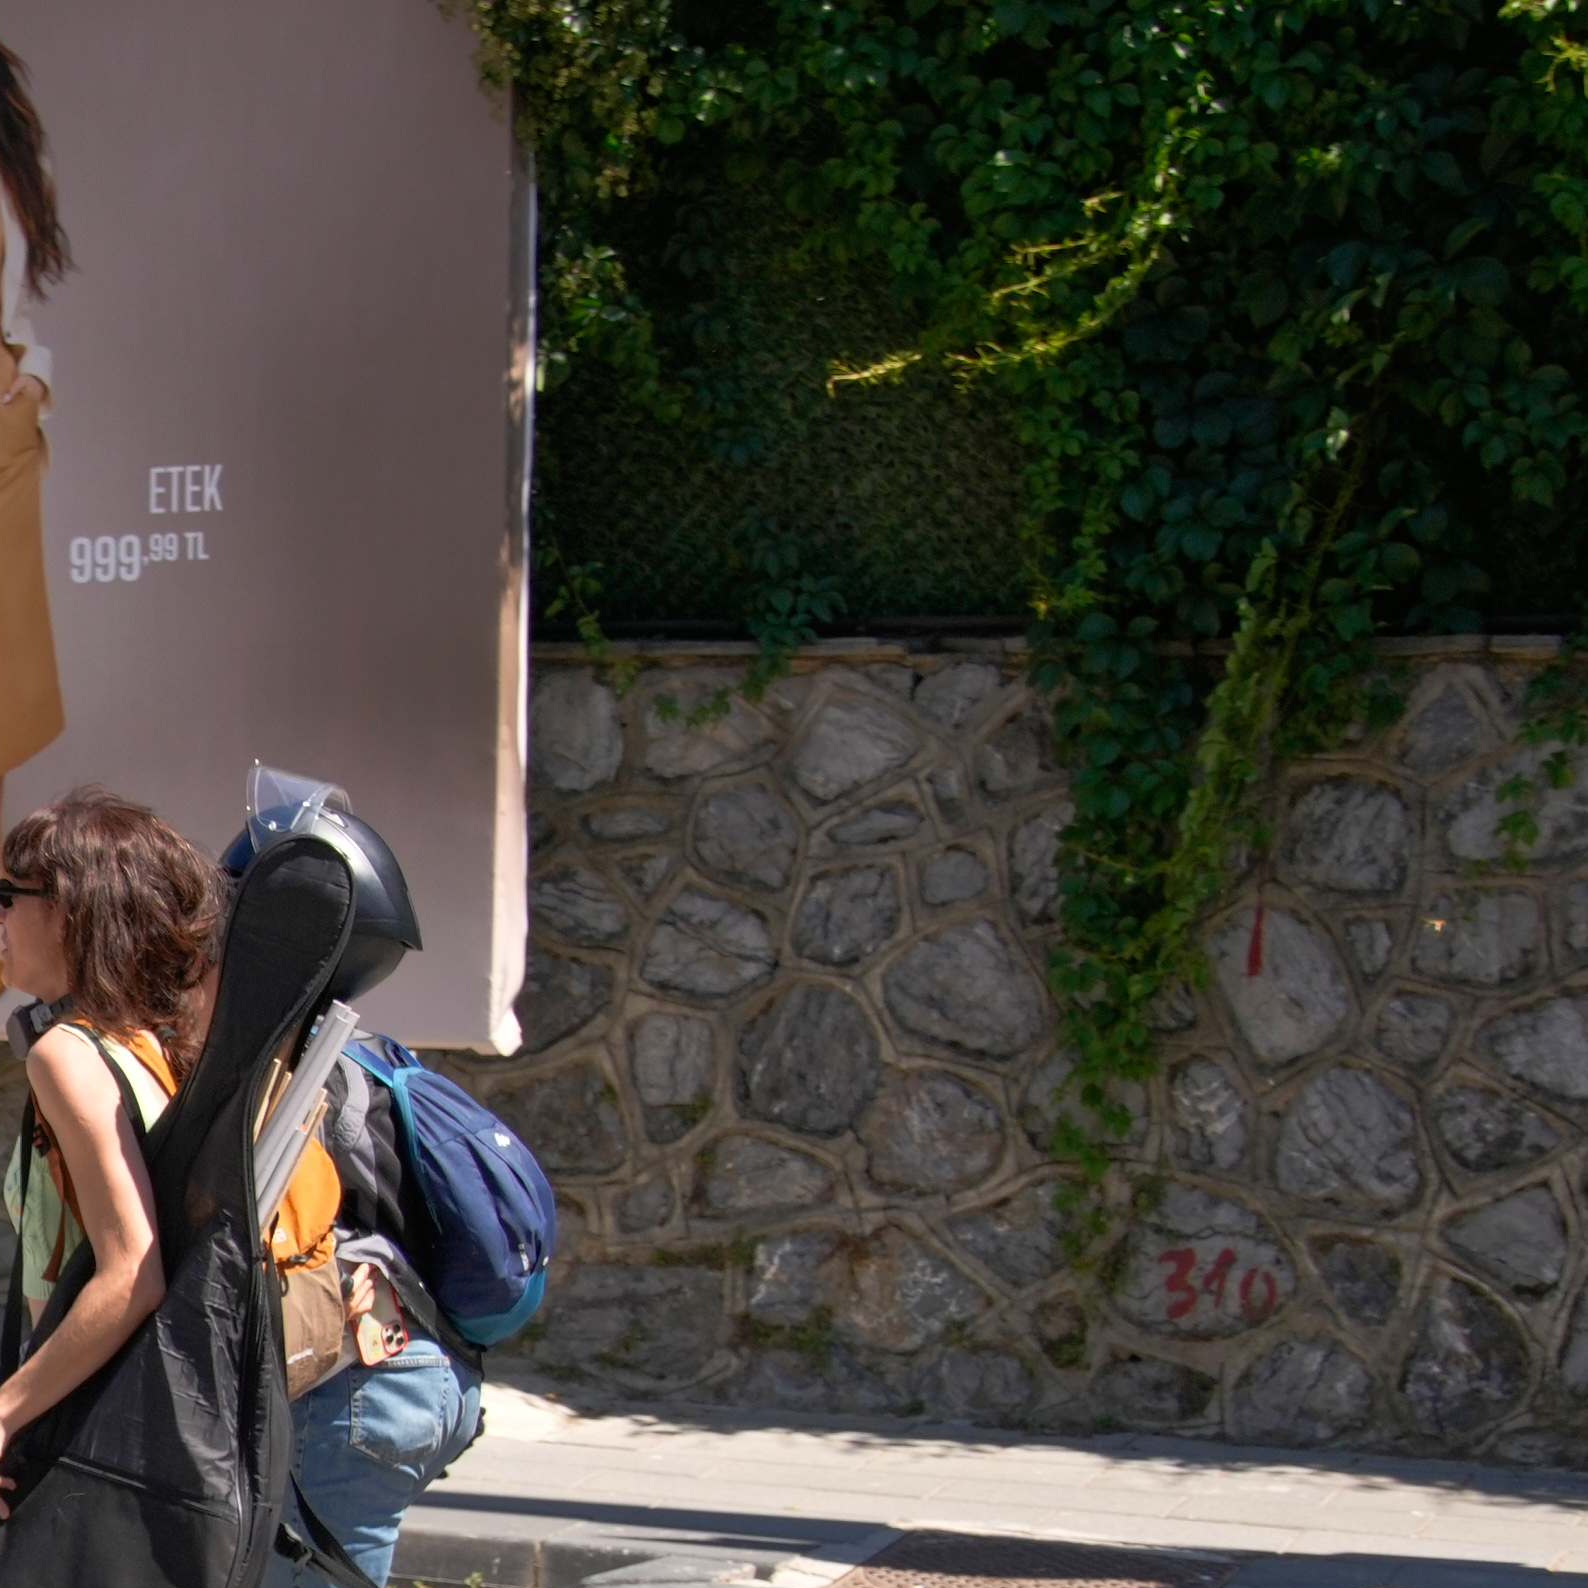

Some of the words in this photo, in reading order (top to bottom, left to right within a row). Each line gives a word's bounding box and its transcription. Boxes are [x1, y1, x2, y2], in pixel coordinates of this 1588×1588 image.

[149, 464, 223, 514] ETEK
[183, 531, 210, 561] TL
[1157, 1248, 1279, 1322] 310
